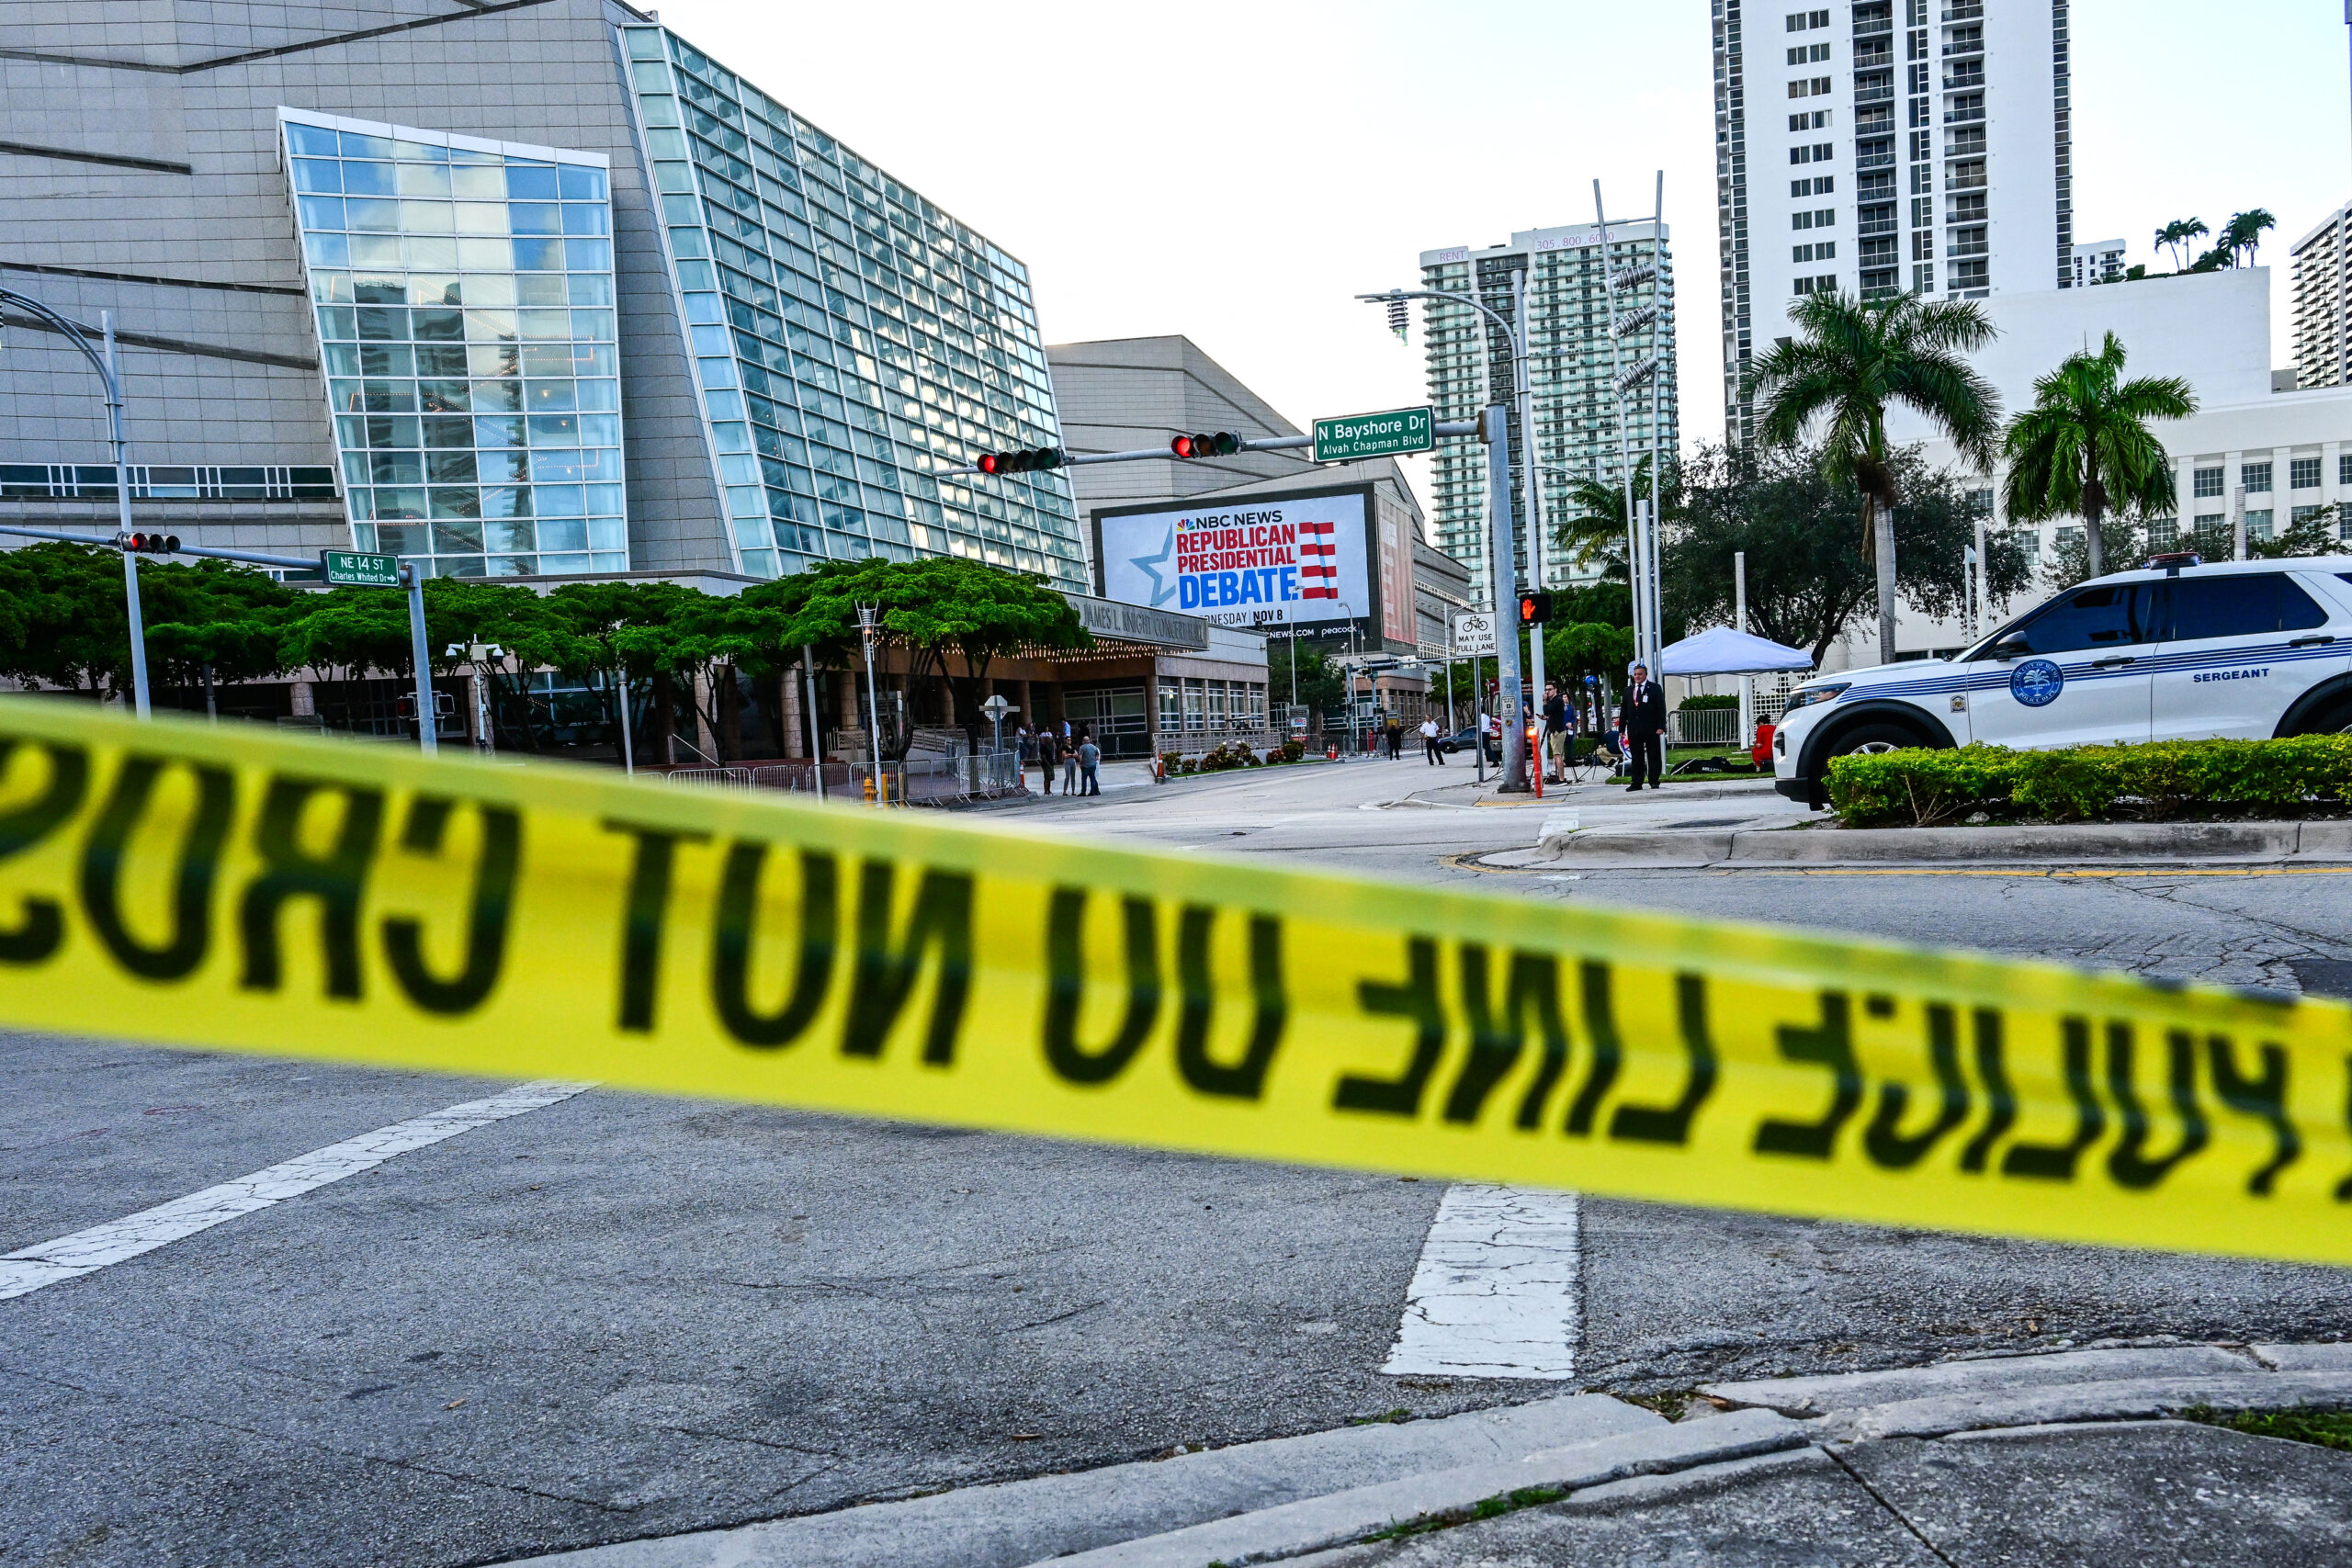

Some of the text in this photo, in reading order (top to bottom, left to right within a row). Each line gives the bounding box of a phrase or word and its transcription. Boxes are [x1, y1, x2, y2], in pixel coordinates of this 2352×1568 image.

[1589, 231, 1614, 243] 600
[1440, 250, 1465, 262] RENT
[1317, 415, 1426, 441] N Bayshore Dr
[1323, 434, 1424, 455] Alvah Chapman Blvd
[1196, 510, 1283, 529] NBC NEWS
[1176, 523, 1295, 554] REPUBLICAN
[340, 556, 384, 570] NE 14 ST
[1178, 547, 1296, 574] PRESIDENTIAL
[331, 570, 387, 582] Charles Whited Dr
[1179, 566, 1298, 610] DEBATE
[1083, 603, 1111, 629] JAMES
[1122, 609, 1150, 634] KNIGHT
[1154, 616, 1185, 640] CONCERT
[1253, 610, 1273, 622] NOV
[1277, 609, 1283, 621] 8
[1321, 626, 1357, 638] peacock
[1459, 634, 1476, 642] MAY
[2193, 668, 2269, 682] SERGEANT
